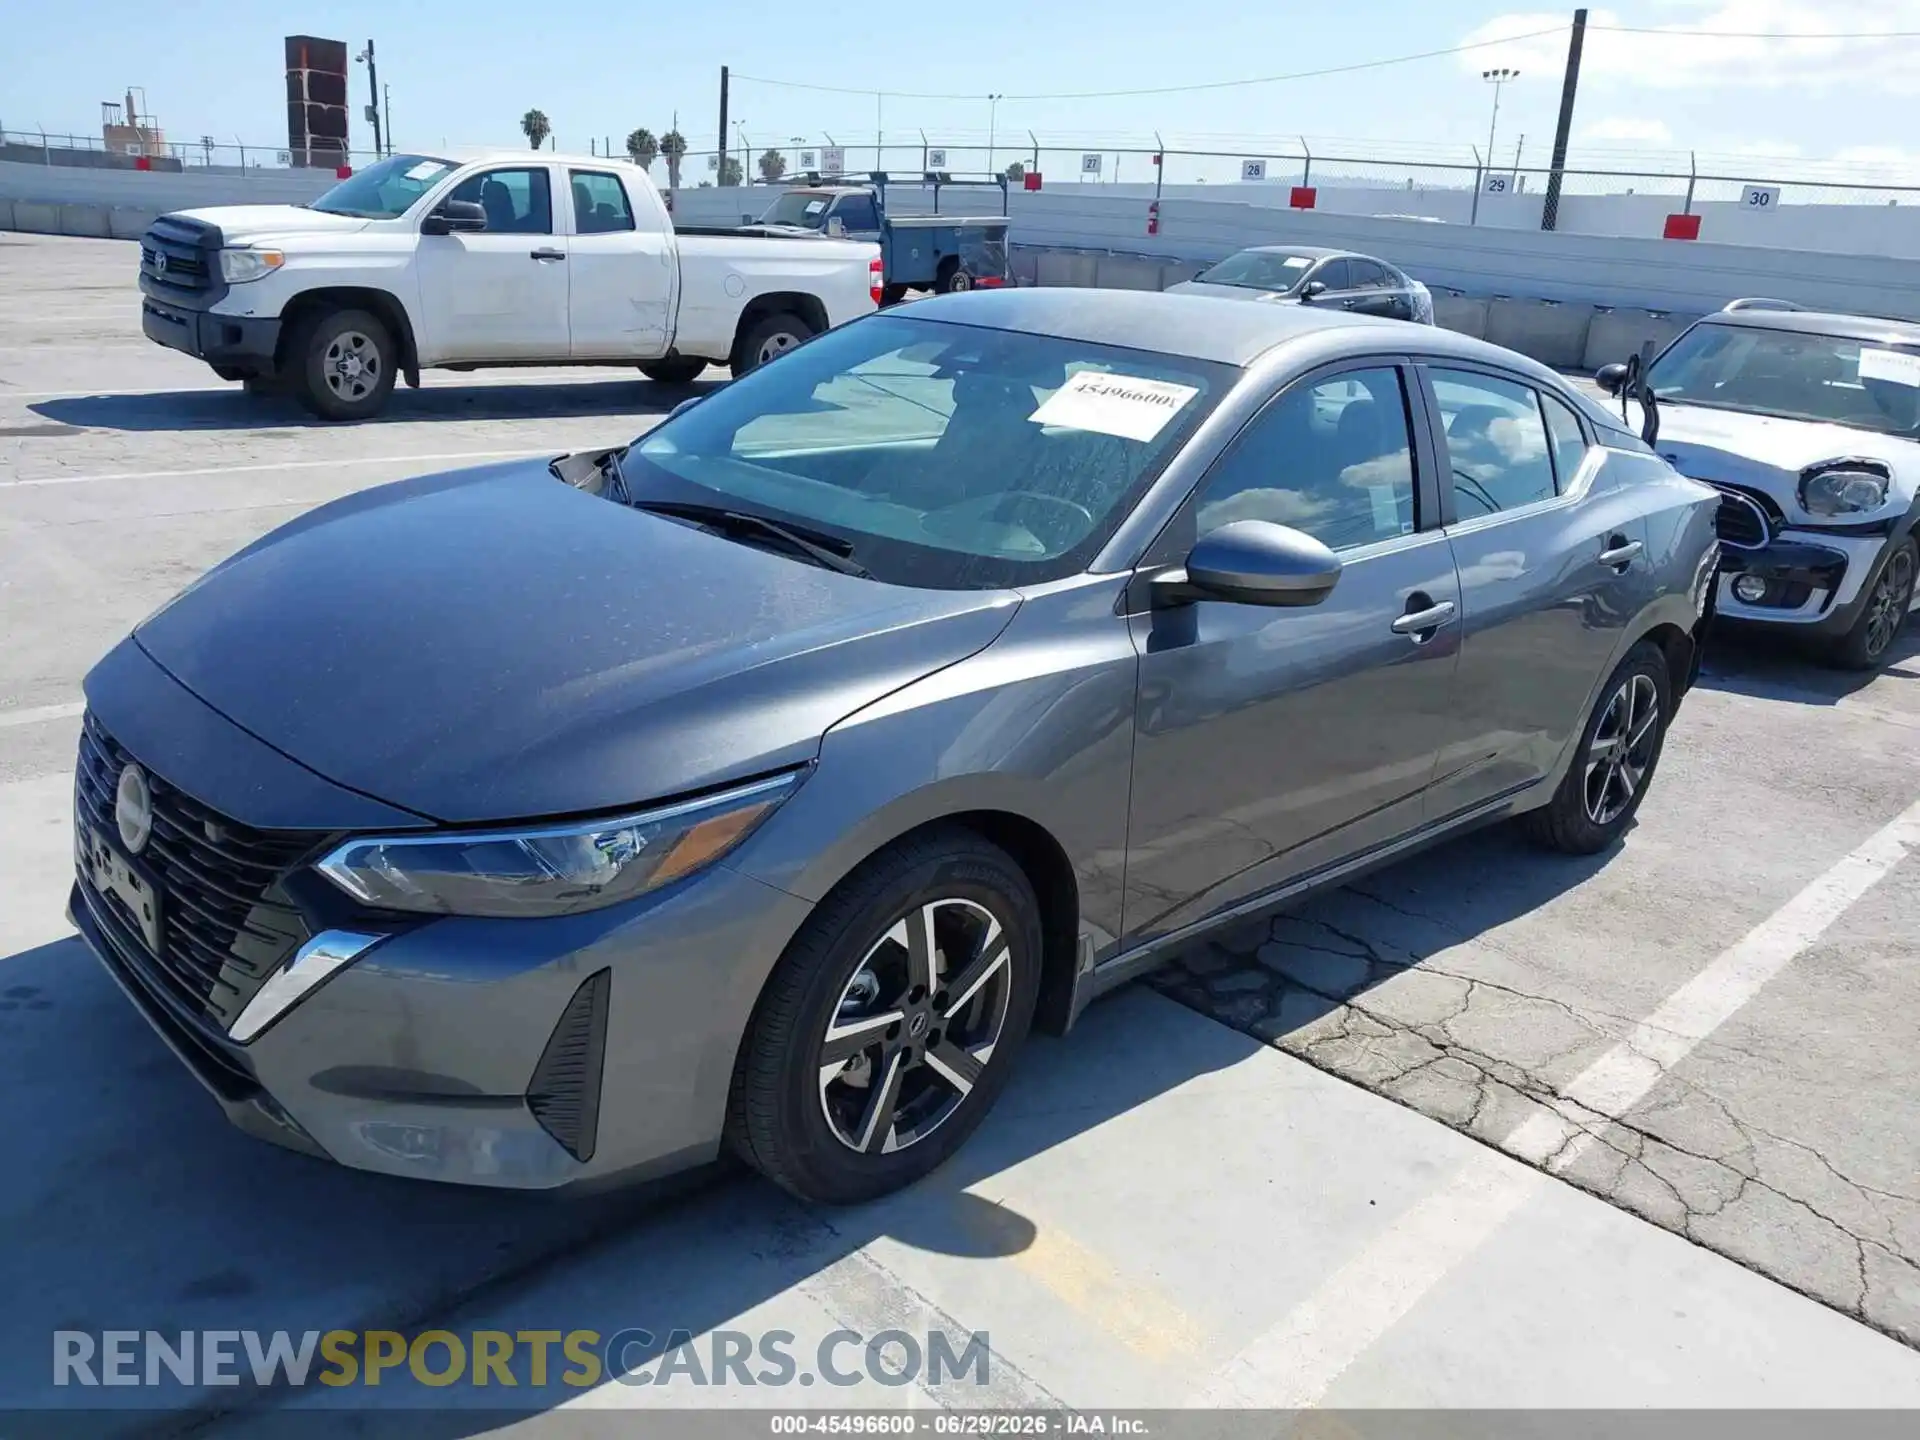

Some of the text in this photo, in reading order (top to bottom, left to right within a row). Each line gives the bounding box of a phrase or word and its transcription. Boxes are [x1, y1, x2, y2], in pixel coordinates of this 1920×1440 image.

[1087, 158, 1097, 169] 27
[1247, 165, 1260, 176] 28
[1488, 180, 1506, 192] 29
[1749, 191, 1770, 207] 30
